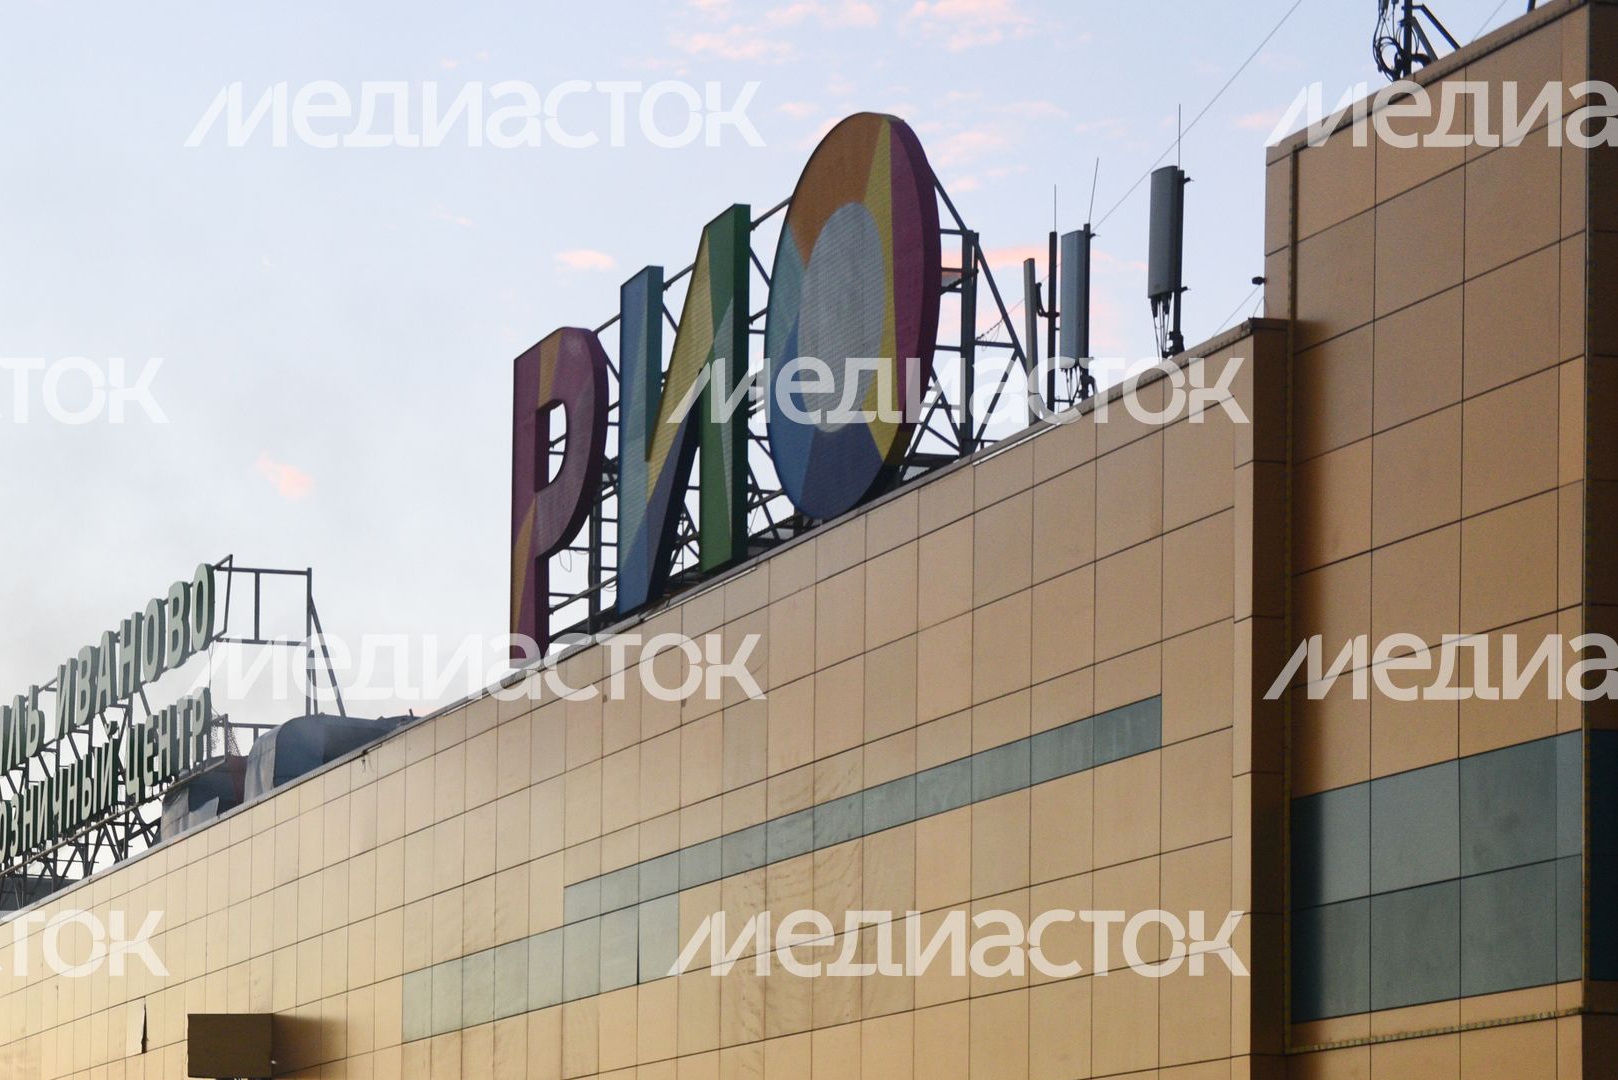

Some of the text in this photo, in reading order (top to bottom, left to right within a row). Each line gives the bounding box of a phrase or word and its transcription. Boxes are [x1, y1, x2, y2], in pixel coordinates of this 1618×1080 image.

[509, 111, 942, 668] РИО
[55, 563, 215, 741] ИВАНОВО
[125, 686, 212, 797] ЦЕНТР
